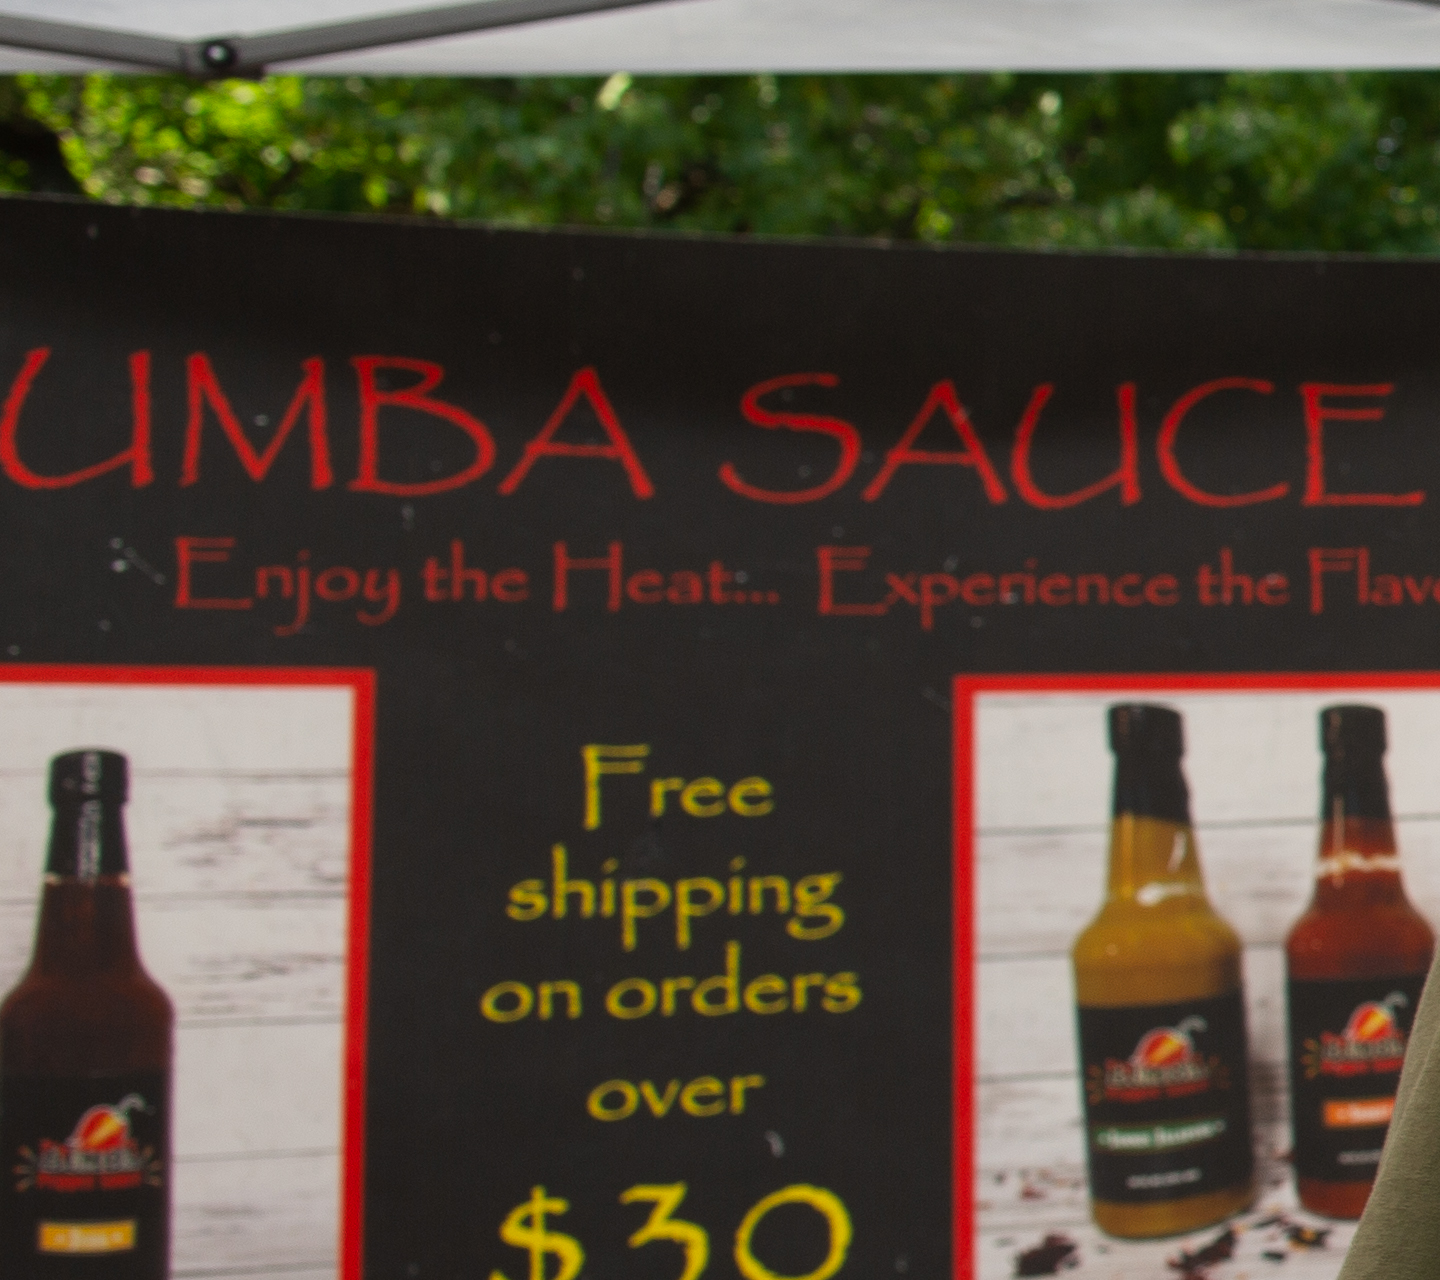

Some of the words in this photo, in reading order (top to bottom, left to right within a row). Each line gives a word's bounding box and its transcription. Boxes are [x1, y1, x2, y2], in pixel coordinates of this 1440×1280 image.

[0, 348, 653, 499] UMBA
[719, 373, 1426, 509] SAUCE
[173, 537, 401, 637] Enjoy
[422, 541, 531, 605] the
[817, 546, 1179, 630] Experience
[1197, 549, 1290, 607] the
[581, 744, 775, 830] Free
[506, 844, 845, 951] shipping
[480, 975, 582, 1024] on
[605, 941, 863, 1022] orders
[586, 1074, 765, 1122] over
